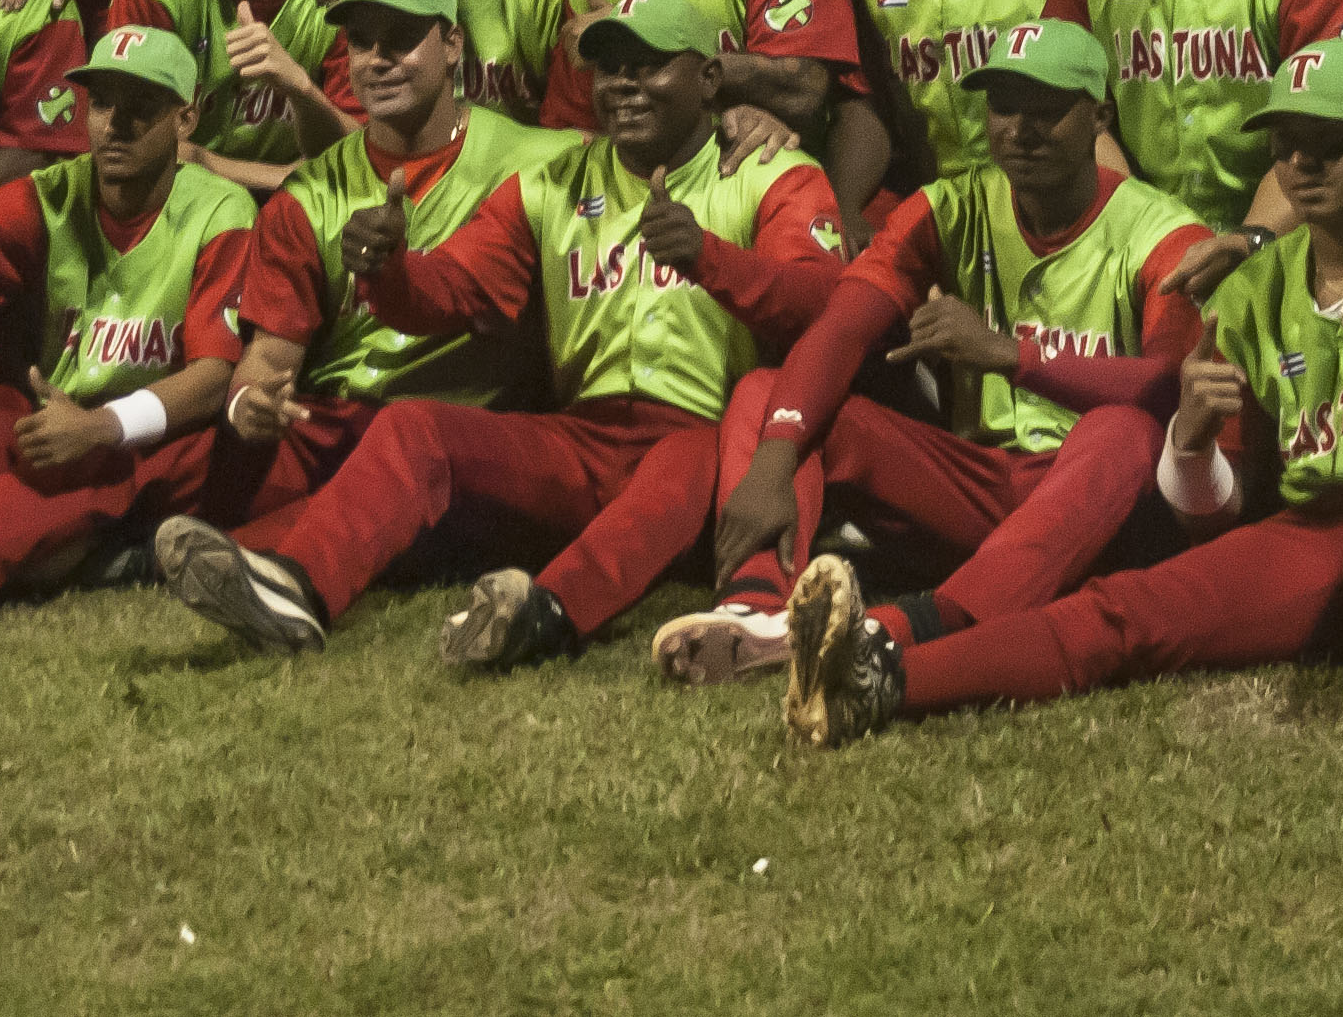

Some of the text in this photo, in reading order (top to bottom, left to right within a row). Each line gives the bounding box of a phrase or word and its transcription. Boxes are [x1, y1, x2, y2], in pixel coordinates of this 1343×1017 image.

[111, 27, 146, 60] T
[890, 34, 940, 84] AS
[1007, 26, 1042, 57] T
[1172, 24, 1273, 84] TUNA
[1287, 52, 1324, 94] T
[569, 244, 625, 299] LAS
